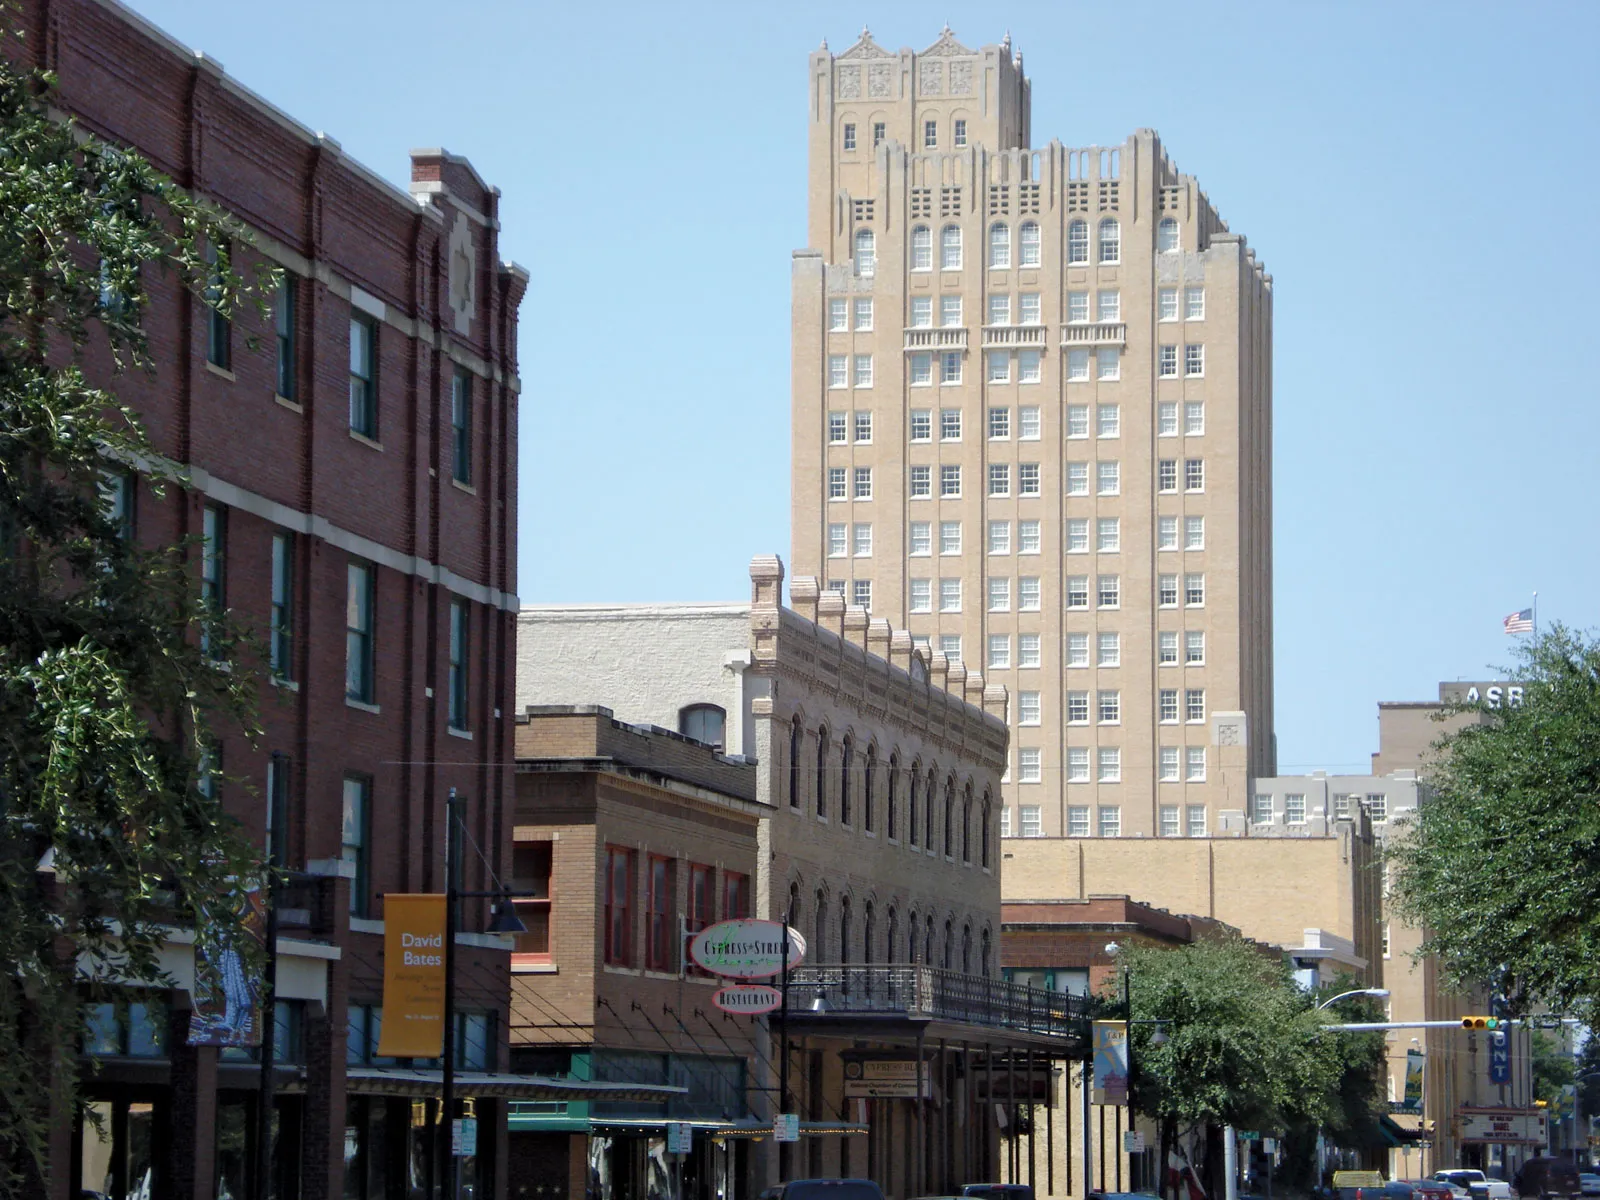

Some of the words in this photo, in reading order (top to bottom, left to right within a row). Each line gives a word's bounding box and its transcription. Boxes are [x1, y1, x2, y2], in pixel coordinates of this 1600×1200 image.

[401, 932, 442, 947] David
[704, 940, 747, 955] CYPRESS
[403, 951, 441, 966] Bates
[719, 991, 775, 1005] RESTAURANT
